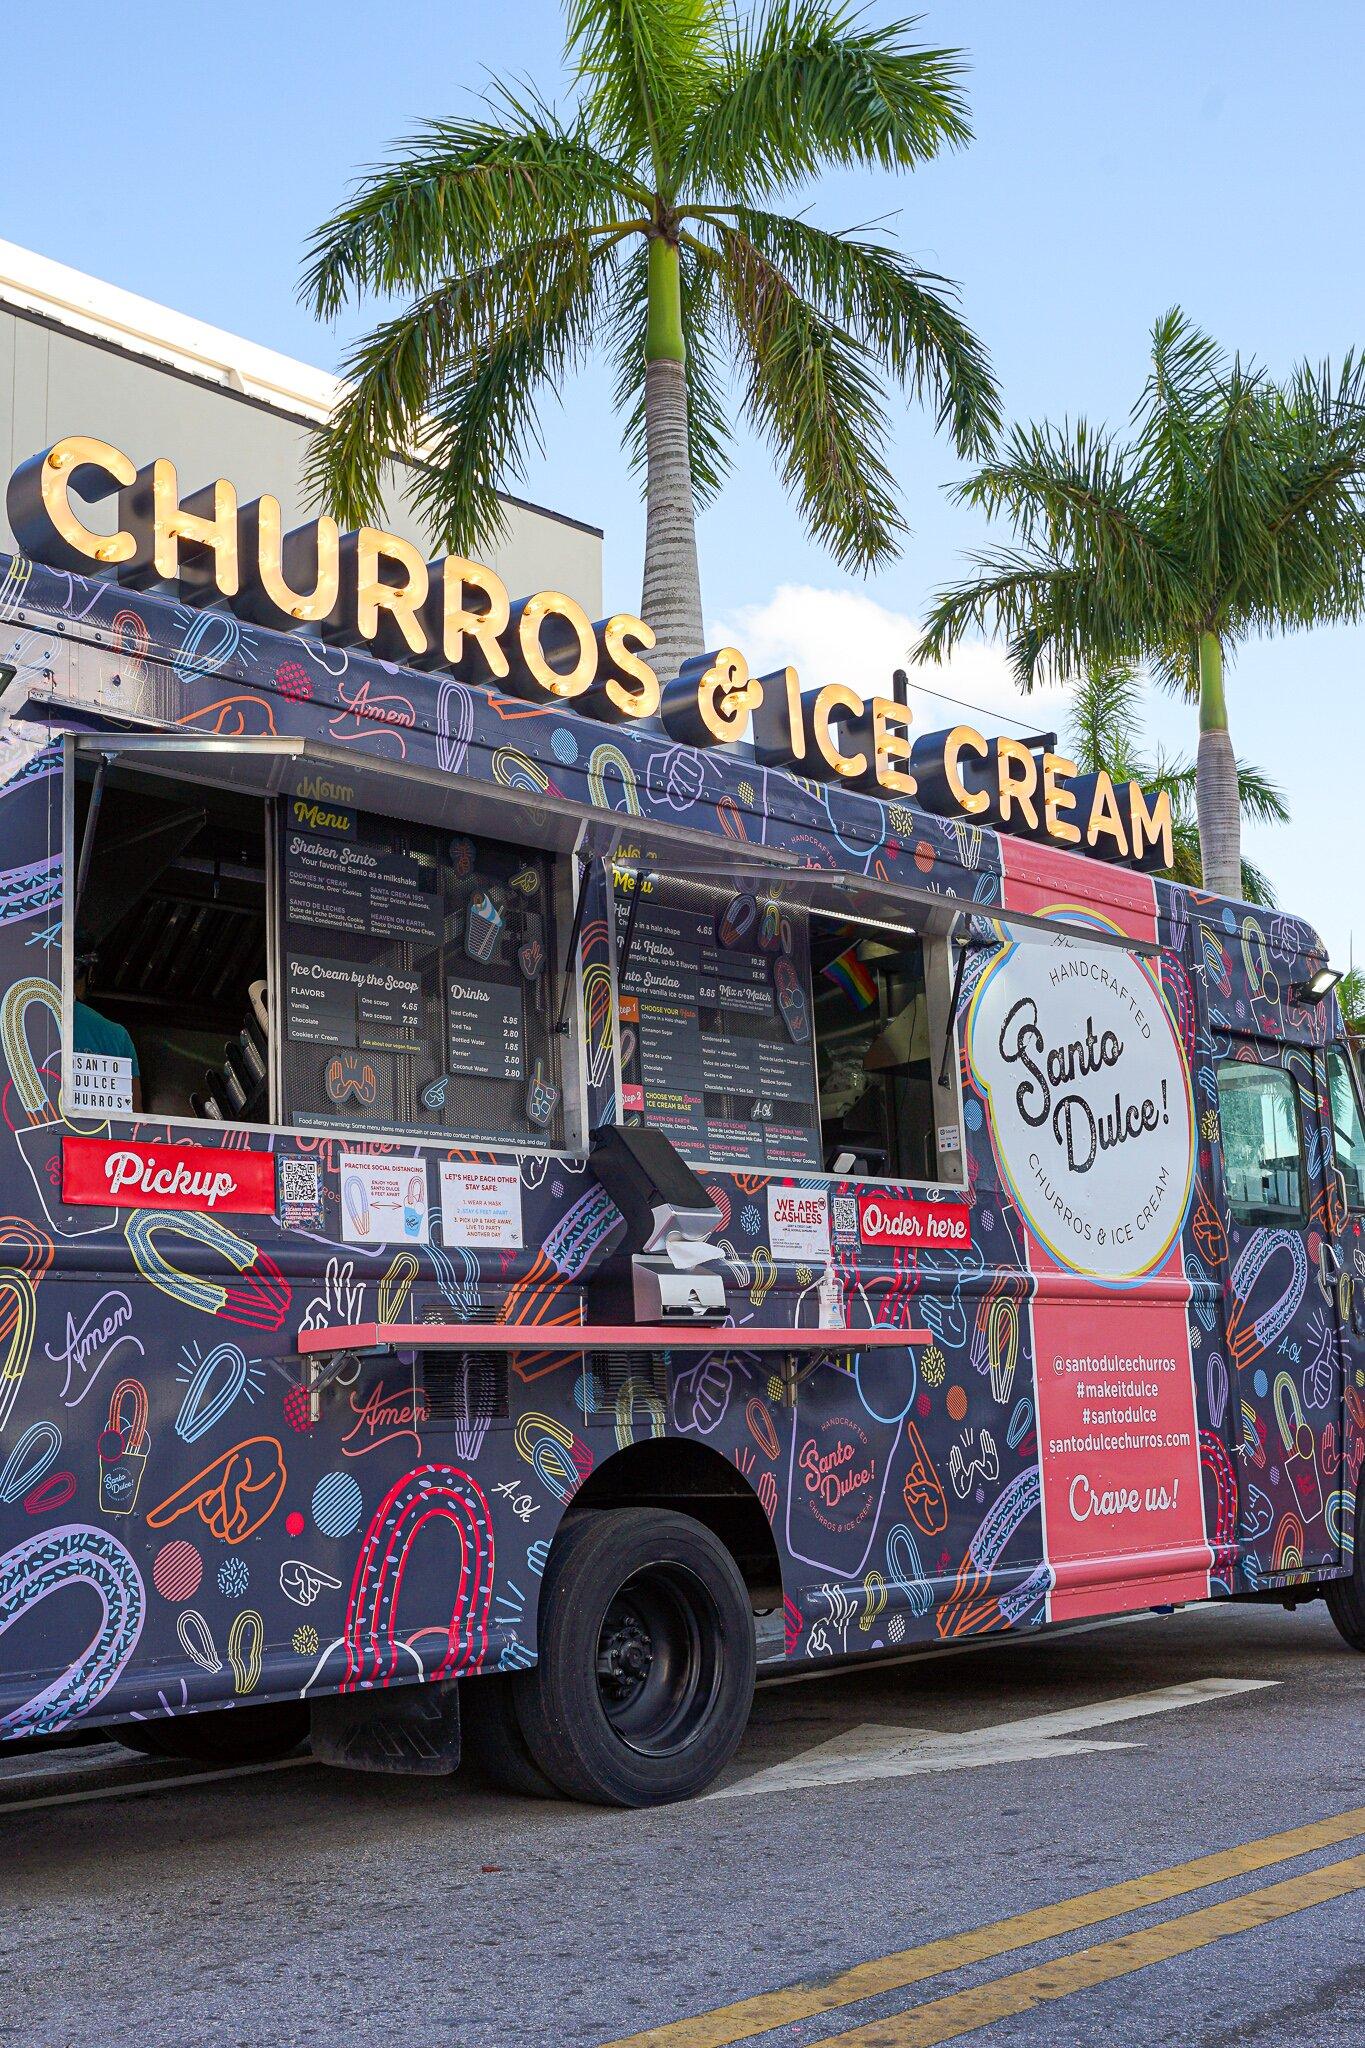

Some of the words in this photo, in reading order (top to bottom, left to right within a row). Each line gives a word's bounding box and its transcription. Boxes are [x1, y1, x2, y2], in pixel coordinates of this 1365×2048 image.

[40, 435, 660, 719] CHURROS
[699, 645, 764, 745] &
[785, 664, 917, 794] ICE
[942, 724, 1174, 869] CREAM
[328, 680, 417, 729] Amen
[293, 801, 351, 831] Menu
[289, 836, 339, 859] Shaken
[339, 847, 377, 867] Santo
[790, 834, 837, 868] HANDCRAFTED
[289, 871, 317, 882] COOKIES
[326, 878, 348, 888] CREAM
[301, 856, 319, 868] Your
[319, 859, 346, 873] favorite
[347, 866, 368, 878] Santo
[368, 871, 377, 879] as
[383, 873, 417, 887] milkshake
[612, 869, 654, 894] Meu
[370, 886, 390, 896] SANTA
[289, 898, 311, 908] SANTO
[312, 902, 321, 910] DE
[322, 904, 346, 914] LECHES
[370, 913, 395, 922] HEAVEN
[405, 919, 425, 927] EARTH
[650, 924, 663, 933] halo
[664, 926, 681, 936] shape
[696, 925, 713, 936] 4.65
[643, 940, 675, 956] Halos
[661, 959, 669, 967] up
[680, 961, 698, 971] flavors
[290, 961, 311, 977] Ice
[311, 964, 350, 982] Cream
[350, 971, 366, 988] by
[366, 973, 385, 986] the
[384, 975, 419, 994] Scoop
[643, 971, 680, 988] Sundae
[290, 987, 325, 998] FLAVORS
[450, 984, 491, 1002] Drinks
[621, 983, 635, 992] Halo
[635, 986, 649, 994] over
[649, 988, 668, 997] vanilla
[668, 990, 677, 998] ice
[290, 1001, 310, 1011] Vanilla
[373, 999, 390, 1007] scoop
[401, 1002, 418, 1011] 4.65
[1048, 960, 1152, 1040] HANDCRAFTED
[450, 1009, 462, 1017] Iced
[462, 1011, 478, 1019] Coffee
[502, 1015, 519, 1025] 3.95
[640, 1004, 663, 1014] CHOOSE
[663, 1007, 679, 1016] YOUR
[291, 1016, 319, 1026] Chocolate
[373, 1013, 392, 1021] scoops
[402, 1015, 418, 1025] 7.25
[291, 1030, 314, 1040] Cookies
[320, 1034, 339, 1042] Cream
[451, 1036, 471, 1045] Bottled
[471, 1038, 486, 1046] Water
[76, 1057, 119, 1073] SANTO
[452, 1063, 474, 1072] Coconut
[473, 1065, 489, 1073] Water
[998, 996, 1124, 1127] Santo
[75, 1074, 116, 1090] DULCE
[74, 1092, 122, 1109] HURROS
[636, 1091, 642, 1101] 2
[645, 1092, 668, 1101] CHOOSE
[667, 1094, 683, 1102] YOUR
[646, 1100, 656, 1108] ICE
[656, 1101, 677, 1110] CREAM
[677, 1103, 692, 1112] BASE
[298, 1117, 313, 1125] Food
[312, 1119, 330, 1127] allergy
[330, 1121, 351, 1130] warning:
[351, 1122, 366, 1130] Some
[380, 1125, 394, 1133] items
[429, 1129, 443, 1137] come
[452, 1131, 470, 1139] contact
[1052, 1079, 1170, 1174] Dulce!
[344, 1162, 371, 1171] PRACTICE
[371, 1164, 391, 1172] SOCIAL
[392, 1165, 424, 1173] DISTANCING
[104, 1151, 238, 1207] Pickup
[444, 1173, 462, 1181] LET'S
[462, 1174, 479, 1182] HELP
[479, 1175, 496, 1183] EACH
[497, 1176, 518, 1184] OTHER
[465, 1183, 480, 1191] STAY
[481, 1184, 498, 1192] SAFE:
[776, 1198, 795, 1212] WE
[797, 1200, 819, 1213] ARE
[1028, 1153, 1093, 1241] CHURROS
[1097, 1228, 1106, 1246] &
[1111, 1223, 1134, 1245] ICE
[1136, 1166, 1171, 1231] CREAM
[774, 1211, 823, 1224] CASHLESS
[862, 1203, 924, 1237] Order
[926, 1213, 967, 1239] here
[44, 1290, 133, 1398] Amen
[1053, 1354, 1176, 1376] @santodulcechurros
[1076, 1380, 1159, 1398] #makeitdulce
[341, 1380, 432, 1442] Amen
[1082, 1405, 1157, 1425] #santodulce
[820, 1417, 869, 1445] HANDCRAFTED
[1049, 1432, 1191, 1454] santodulcechurros.com
[798, 1438, 856, 1492] Santo
[819, 1459, 875, 1507] Dulce!
[1069, 1474, 1142, 1522] Crave
[1144, 1478, 1179, 1512] us!
[809, 1499, 836, 1532] CHURROS
[844, 1521, 856, 1531] ICE
[856, 1495, 874, 1524] CREAM
